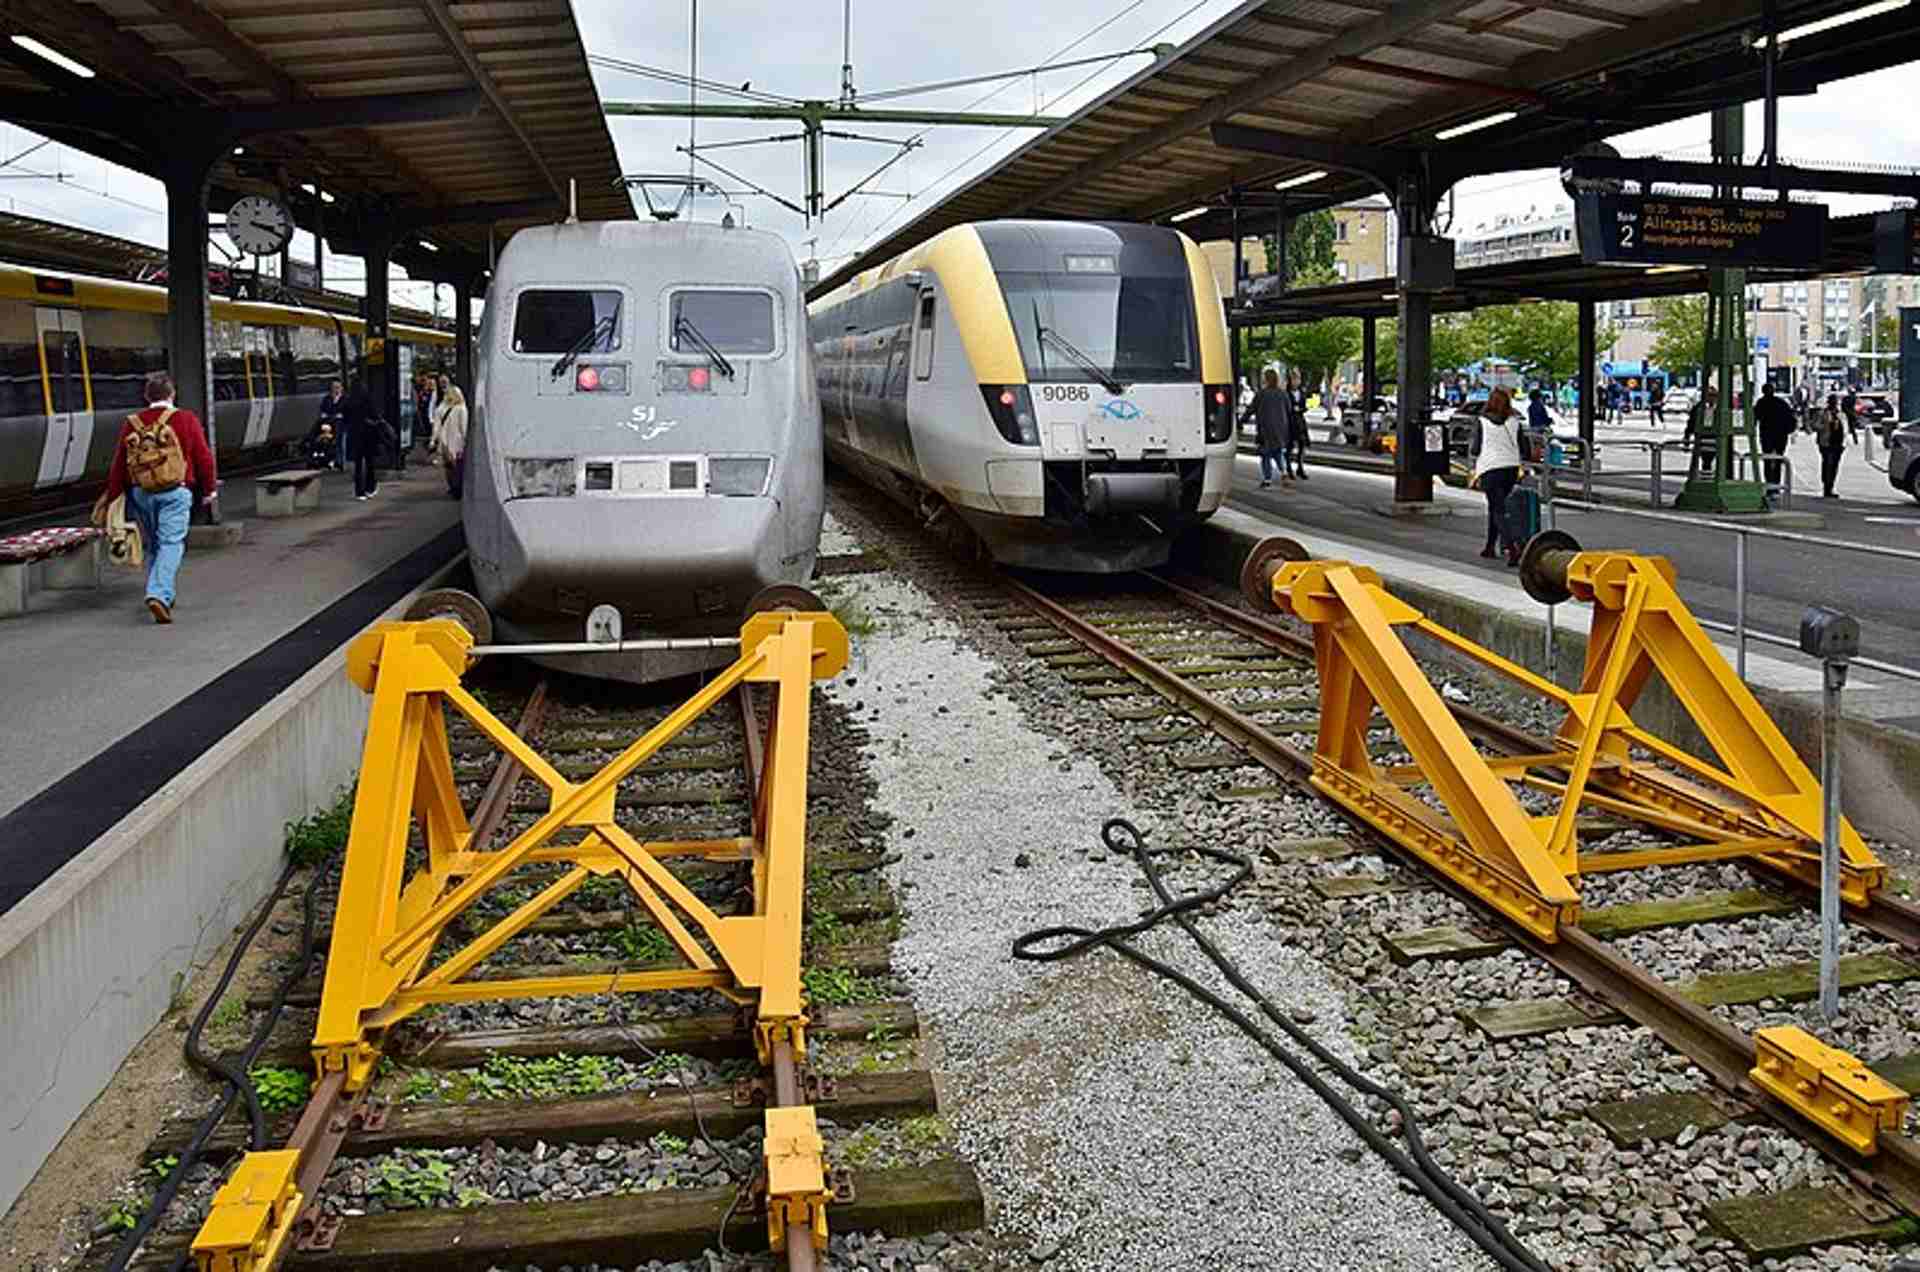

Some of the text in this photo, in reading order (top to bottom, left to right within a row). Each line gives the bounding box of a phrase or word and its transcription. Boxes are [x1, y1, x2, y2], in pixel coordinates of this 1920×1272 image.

[1620, 224, 1633, 248] 2
[1043, 385, 1090, 401] 9086
[631, 405, 655, 422] SJ
